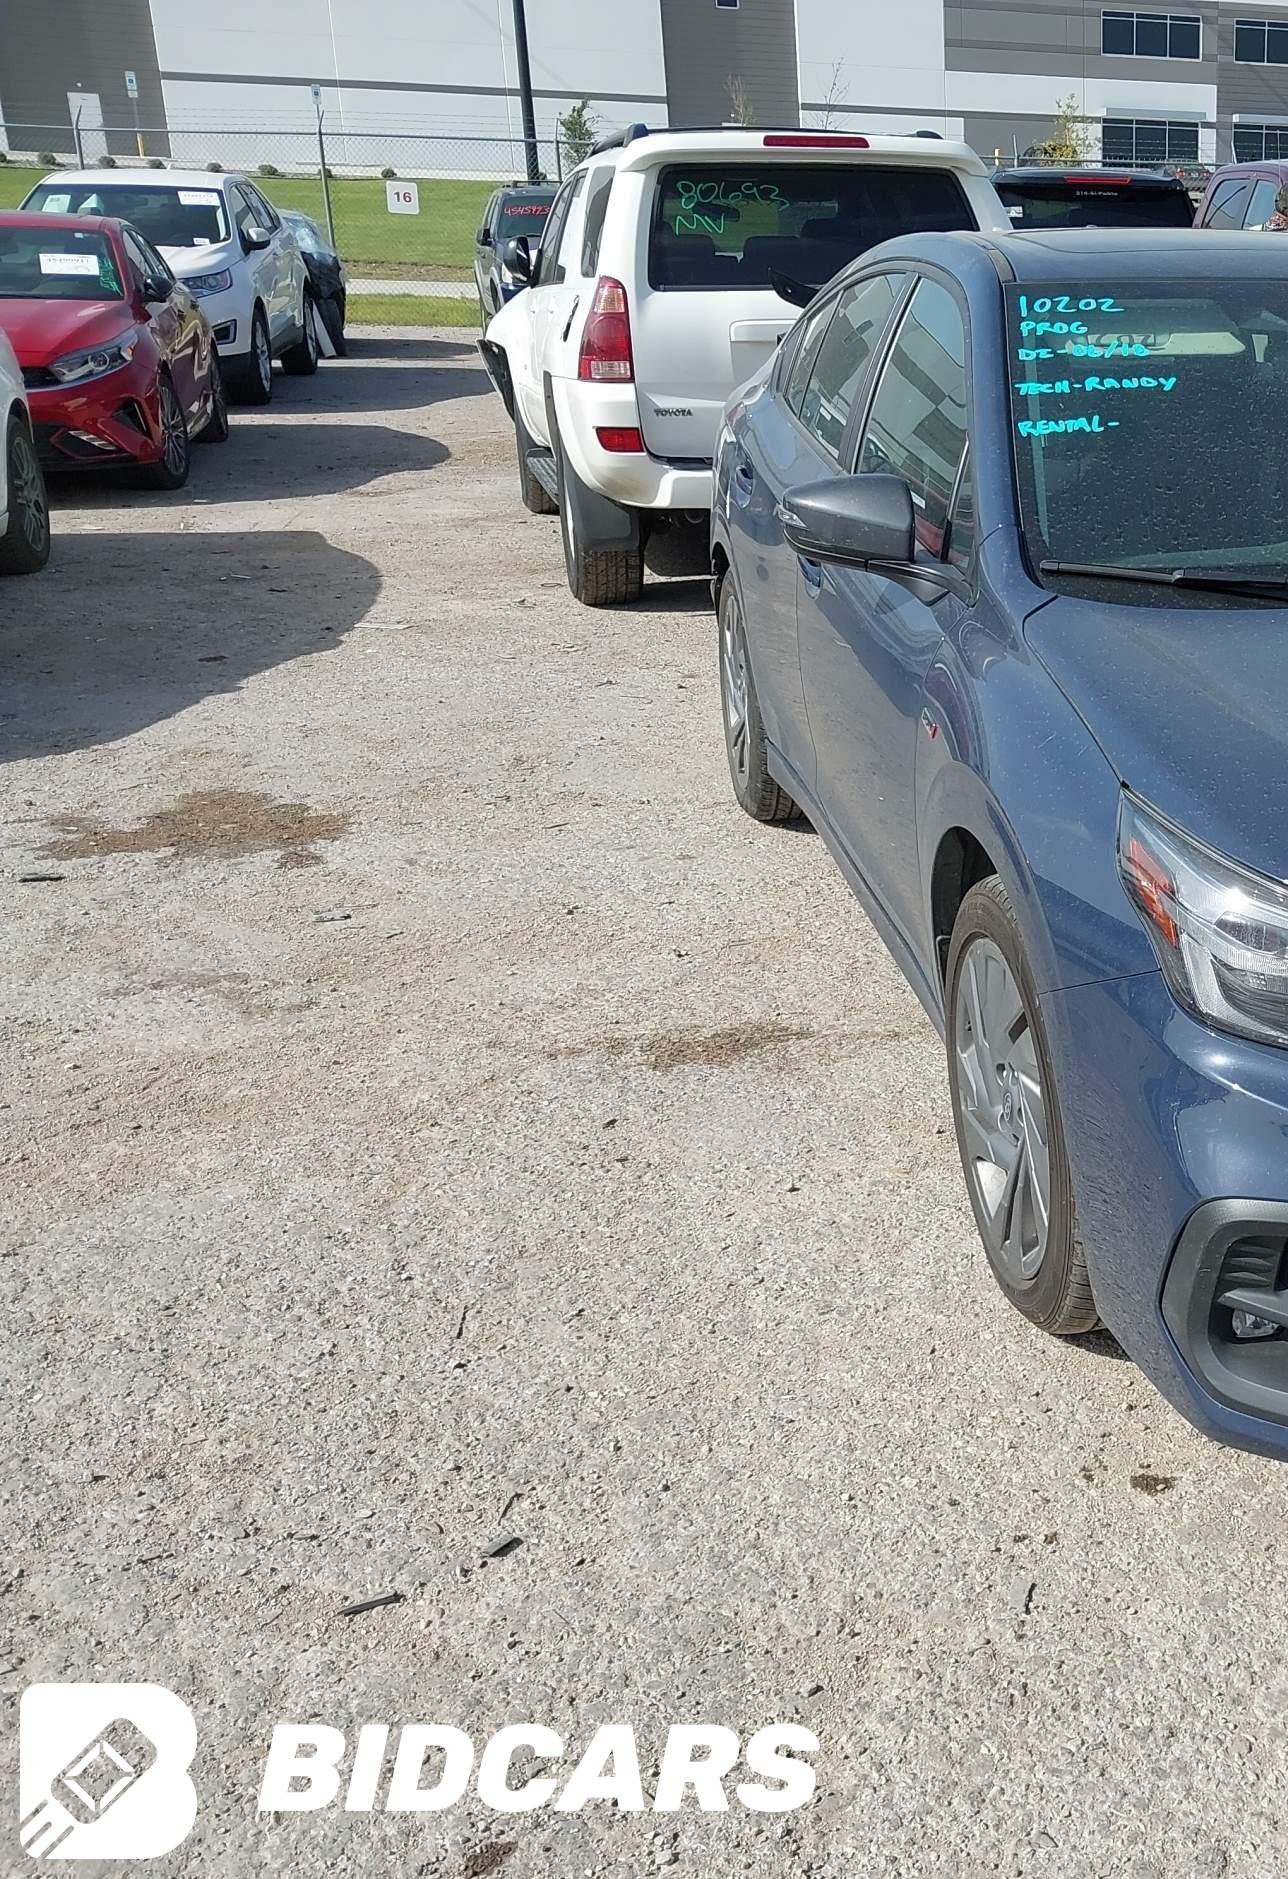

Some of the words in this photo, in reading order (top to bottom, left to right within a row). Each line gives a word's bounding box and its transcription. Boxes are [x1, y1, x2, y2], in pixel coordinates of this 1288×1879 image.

[393, 191, 412, 203] 16
[1018, 295, 1126, 318] 10202
[1019, 319, 1089, 337] PROG
[653, 408, 693, 417] TOYOTA
